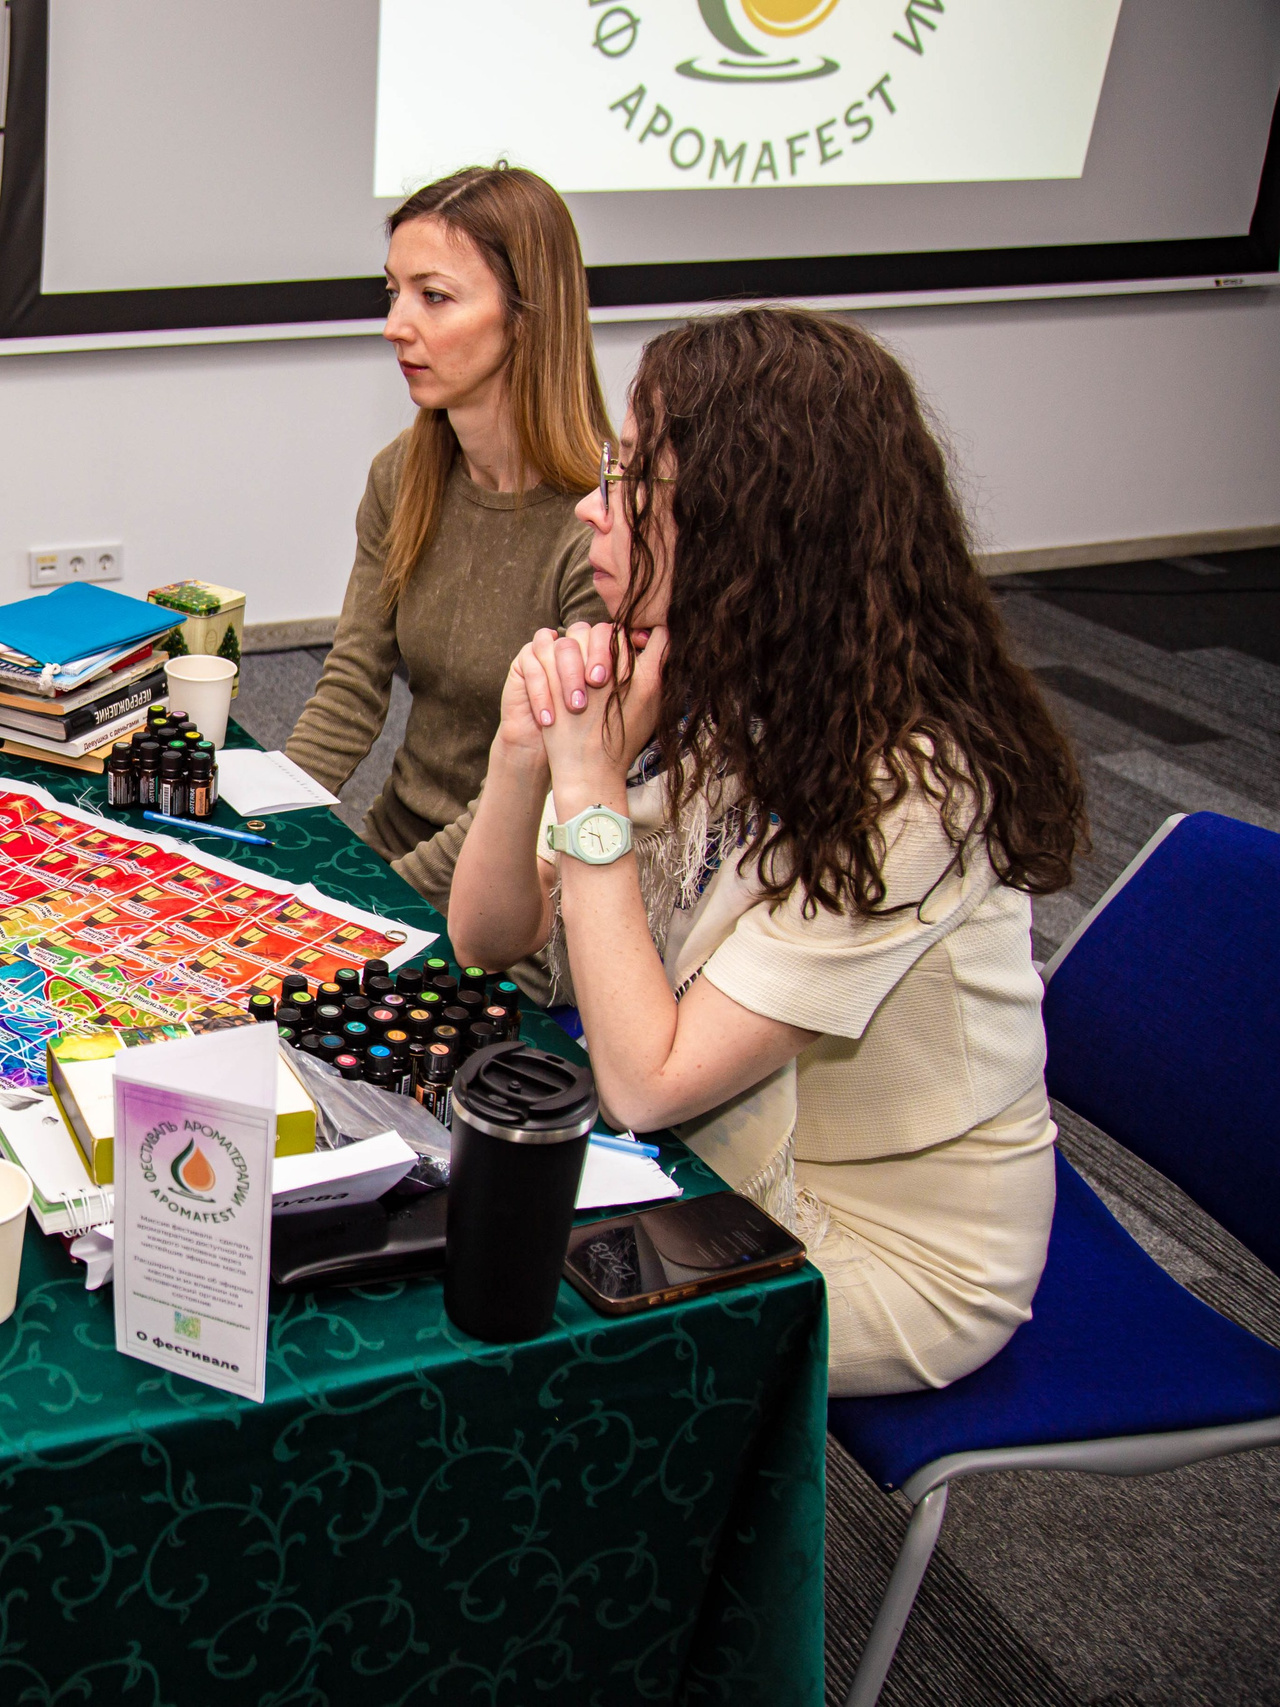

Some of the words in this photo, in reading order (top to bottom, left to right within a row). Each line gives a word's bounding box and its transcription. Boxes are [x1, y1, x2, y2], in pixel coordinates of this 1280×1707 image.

[94, 687, 152, 725] ПЕРЕРОЖДЕНИЕ
[83, 733, 109, 751] Девушка
[113, 719, 140, 736] деньгами
[172, 923, 204, 939] Ревность
[129, 993, 172, 1013] Чистилище
[140, 1120, 178, 1183] ФЕСТИВАЛЬ
[183, 1119, 250, 1208] АРОМАТЕРАПИИ
[136, 1223, 194, 1244] ароматерапию
[195, 1239, 237, 1256] доступной
[238, 1251, 254, 1261] для
[140, 1215, 170, 1228] Миссия
[172, 1223, 213, 1240] фестиваля
[219, 1238, 251, 1251] сделать
[141, 1241, 184, 1258] чистейшие
[185, 1253, 221, 1269] эфирные
[222, 1265, 247, 1276] масла
[147, 1234, 180, 1250] каждого
[181, 1244, 217, 1259] человека
[218, 1255, 242, 1268] через
[133, 1255, 177, 1273] Расширить
[178, 1269, 206, 1281] знания
[207, 1275, 218, 1284] об
[219, 1280, 254, 1296] эфирных
[147, 1268, 174, 1280] маслах
[143, 1275, 197, 1298] человеческий
[198, 1292, 237, 1308] организм
[171, 1291, 212, 1308] состояние
[136, 1330, 148, 1342] О
[152, 1336, 240, 1373] фестивале
